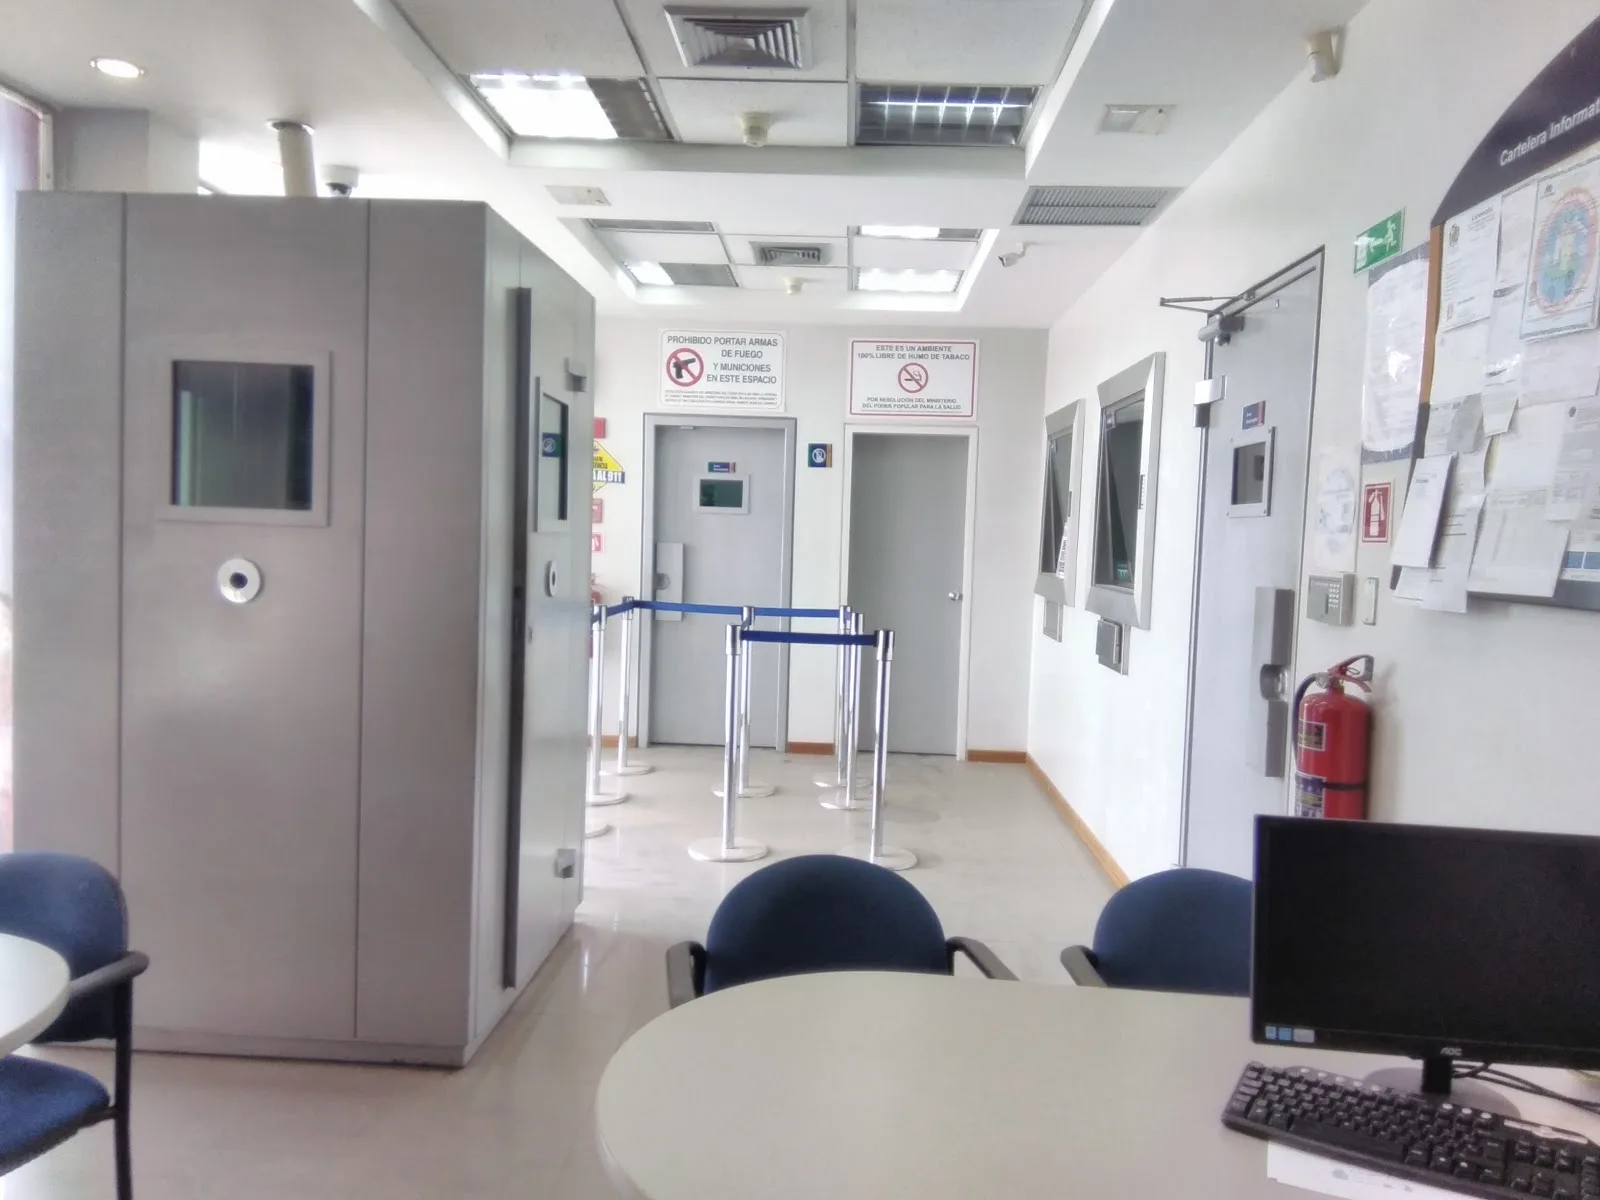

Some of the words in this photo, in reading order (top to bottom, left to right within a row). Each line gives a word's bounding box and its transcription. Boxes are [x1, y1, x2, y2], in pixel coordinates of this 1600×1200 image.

[1500, 130, 1548, 166] Cartelera
[668, 336, 712, 345] PROHIBIDO
[714, 337, 746, 346] PORTAR
[749, 338, 778, 346] ARMAS
[735, 350, 763, 358] FUEGO
[713, 362, 719, 370] Y
[720, 364, 771, 372] MUNICIONES
[707, 374, 718, 382] EN
[720, 375, 740, 383] ESTE
[742, 376, 777, 384] ESPACIO
[607, 471, 622, 482] 911
[1440, 1047, 1462, 1056] AOC
